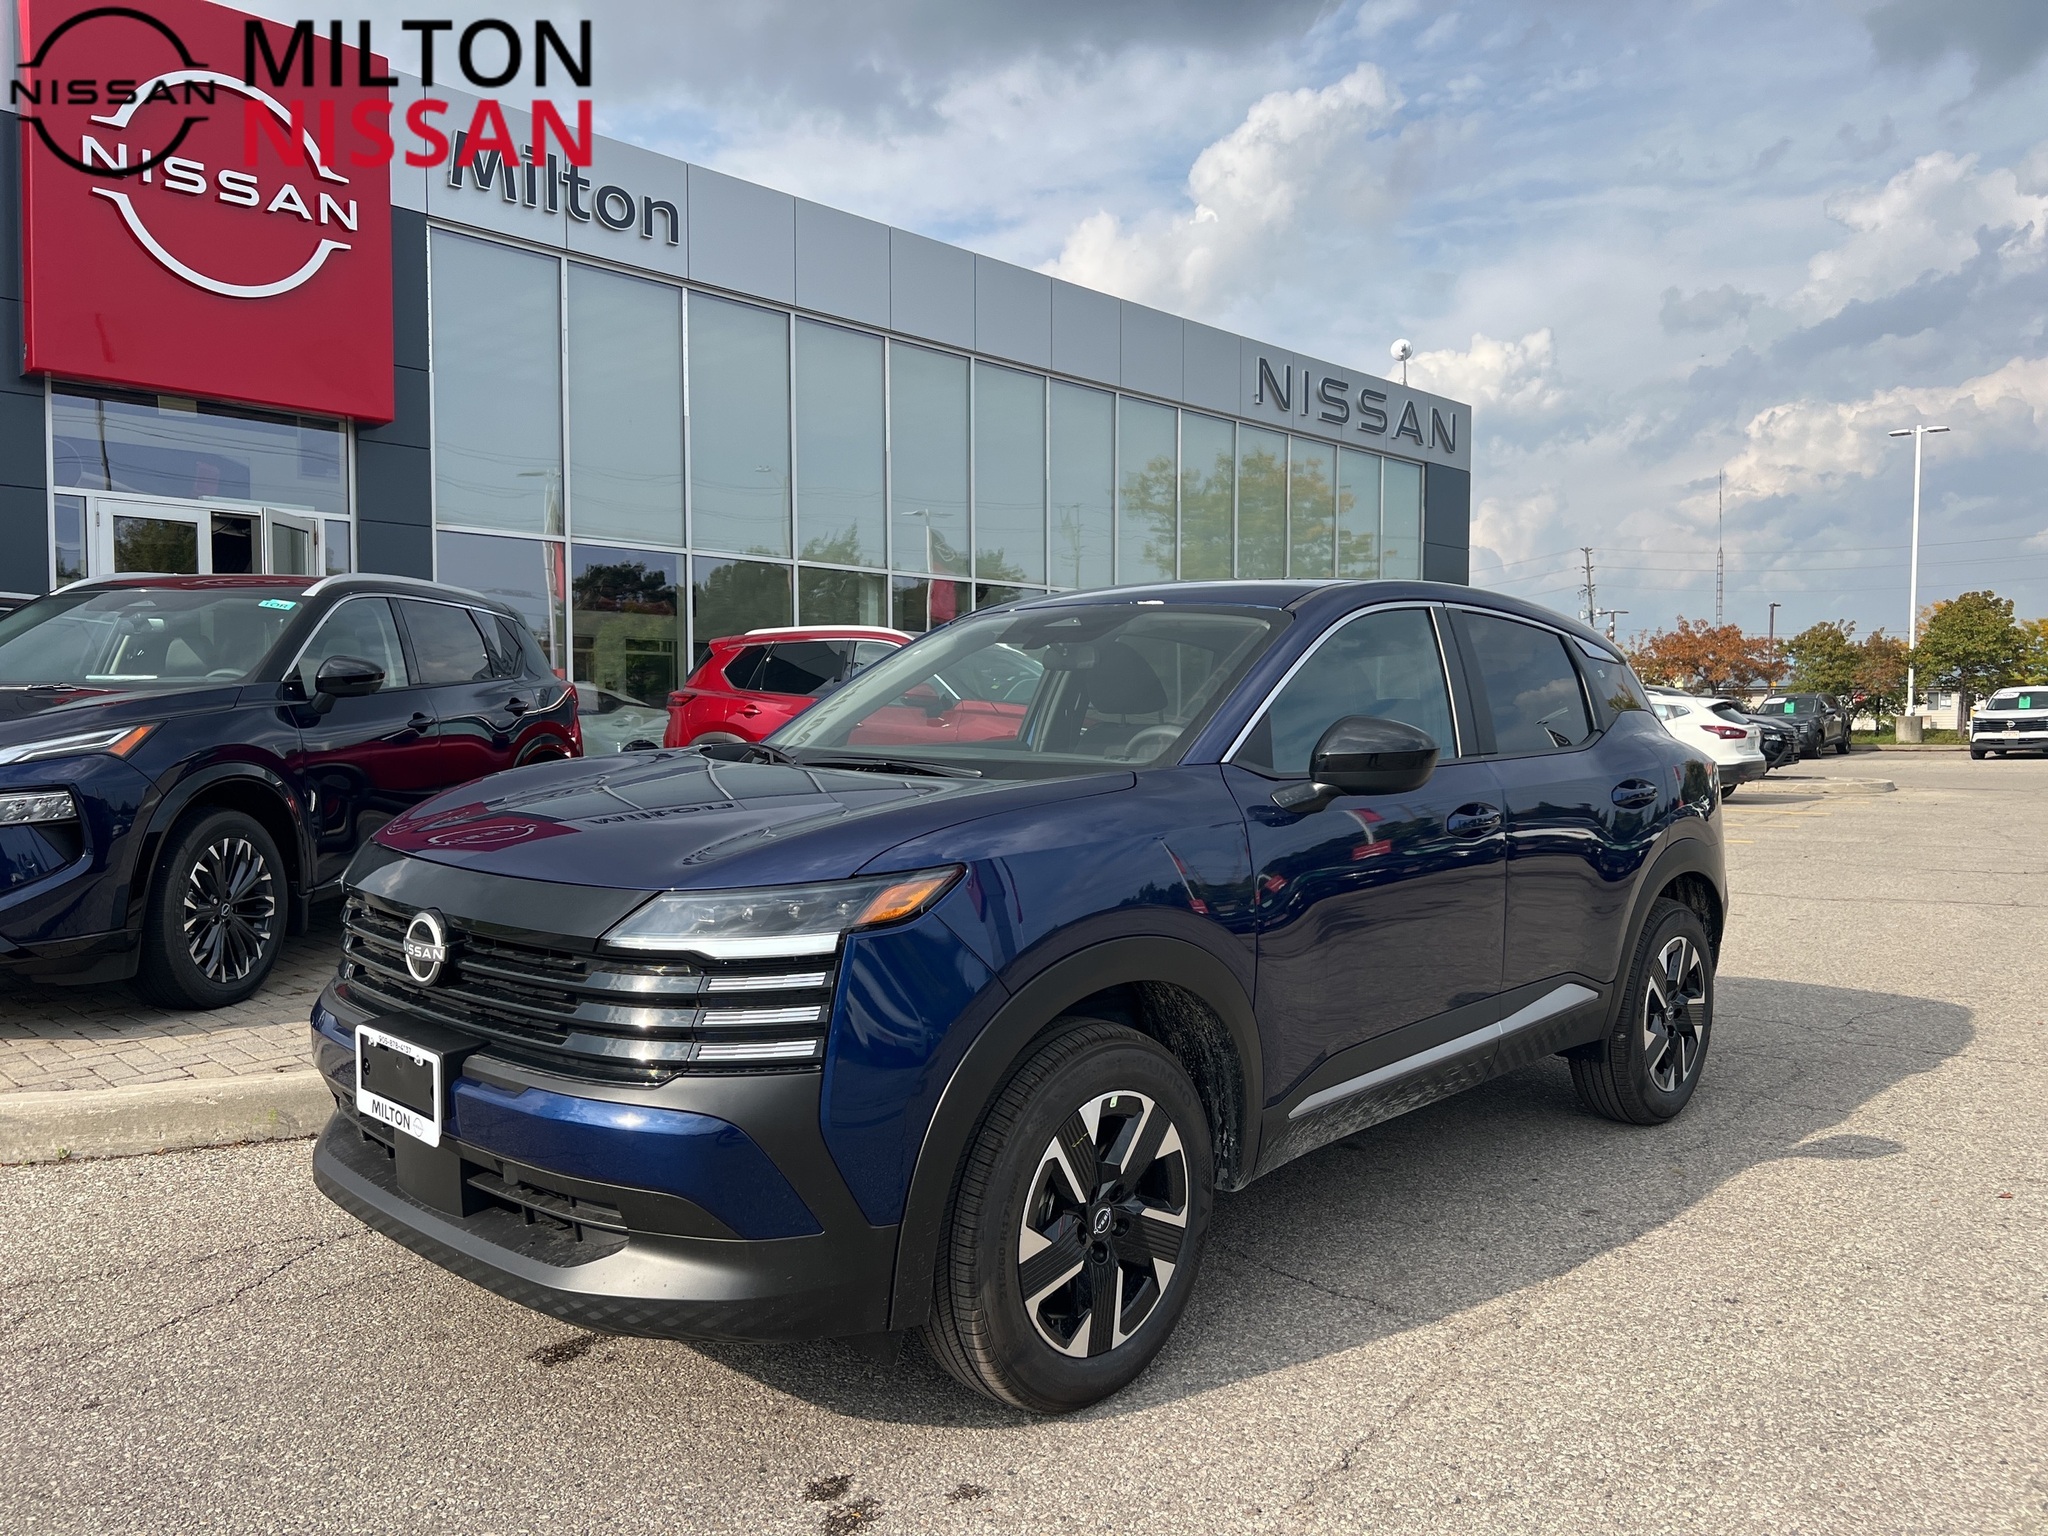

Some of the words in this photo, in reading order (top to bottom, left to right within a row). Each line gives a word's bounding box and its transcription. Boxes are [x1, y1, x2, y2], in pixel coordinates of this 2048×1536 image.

[80, 134, 358, 231] NISSAN
[447, 129, 680, 246] Milton
[1255, 356, 1457, 454] NISSAN
[371, 1099, 411, 1131] MILTON
